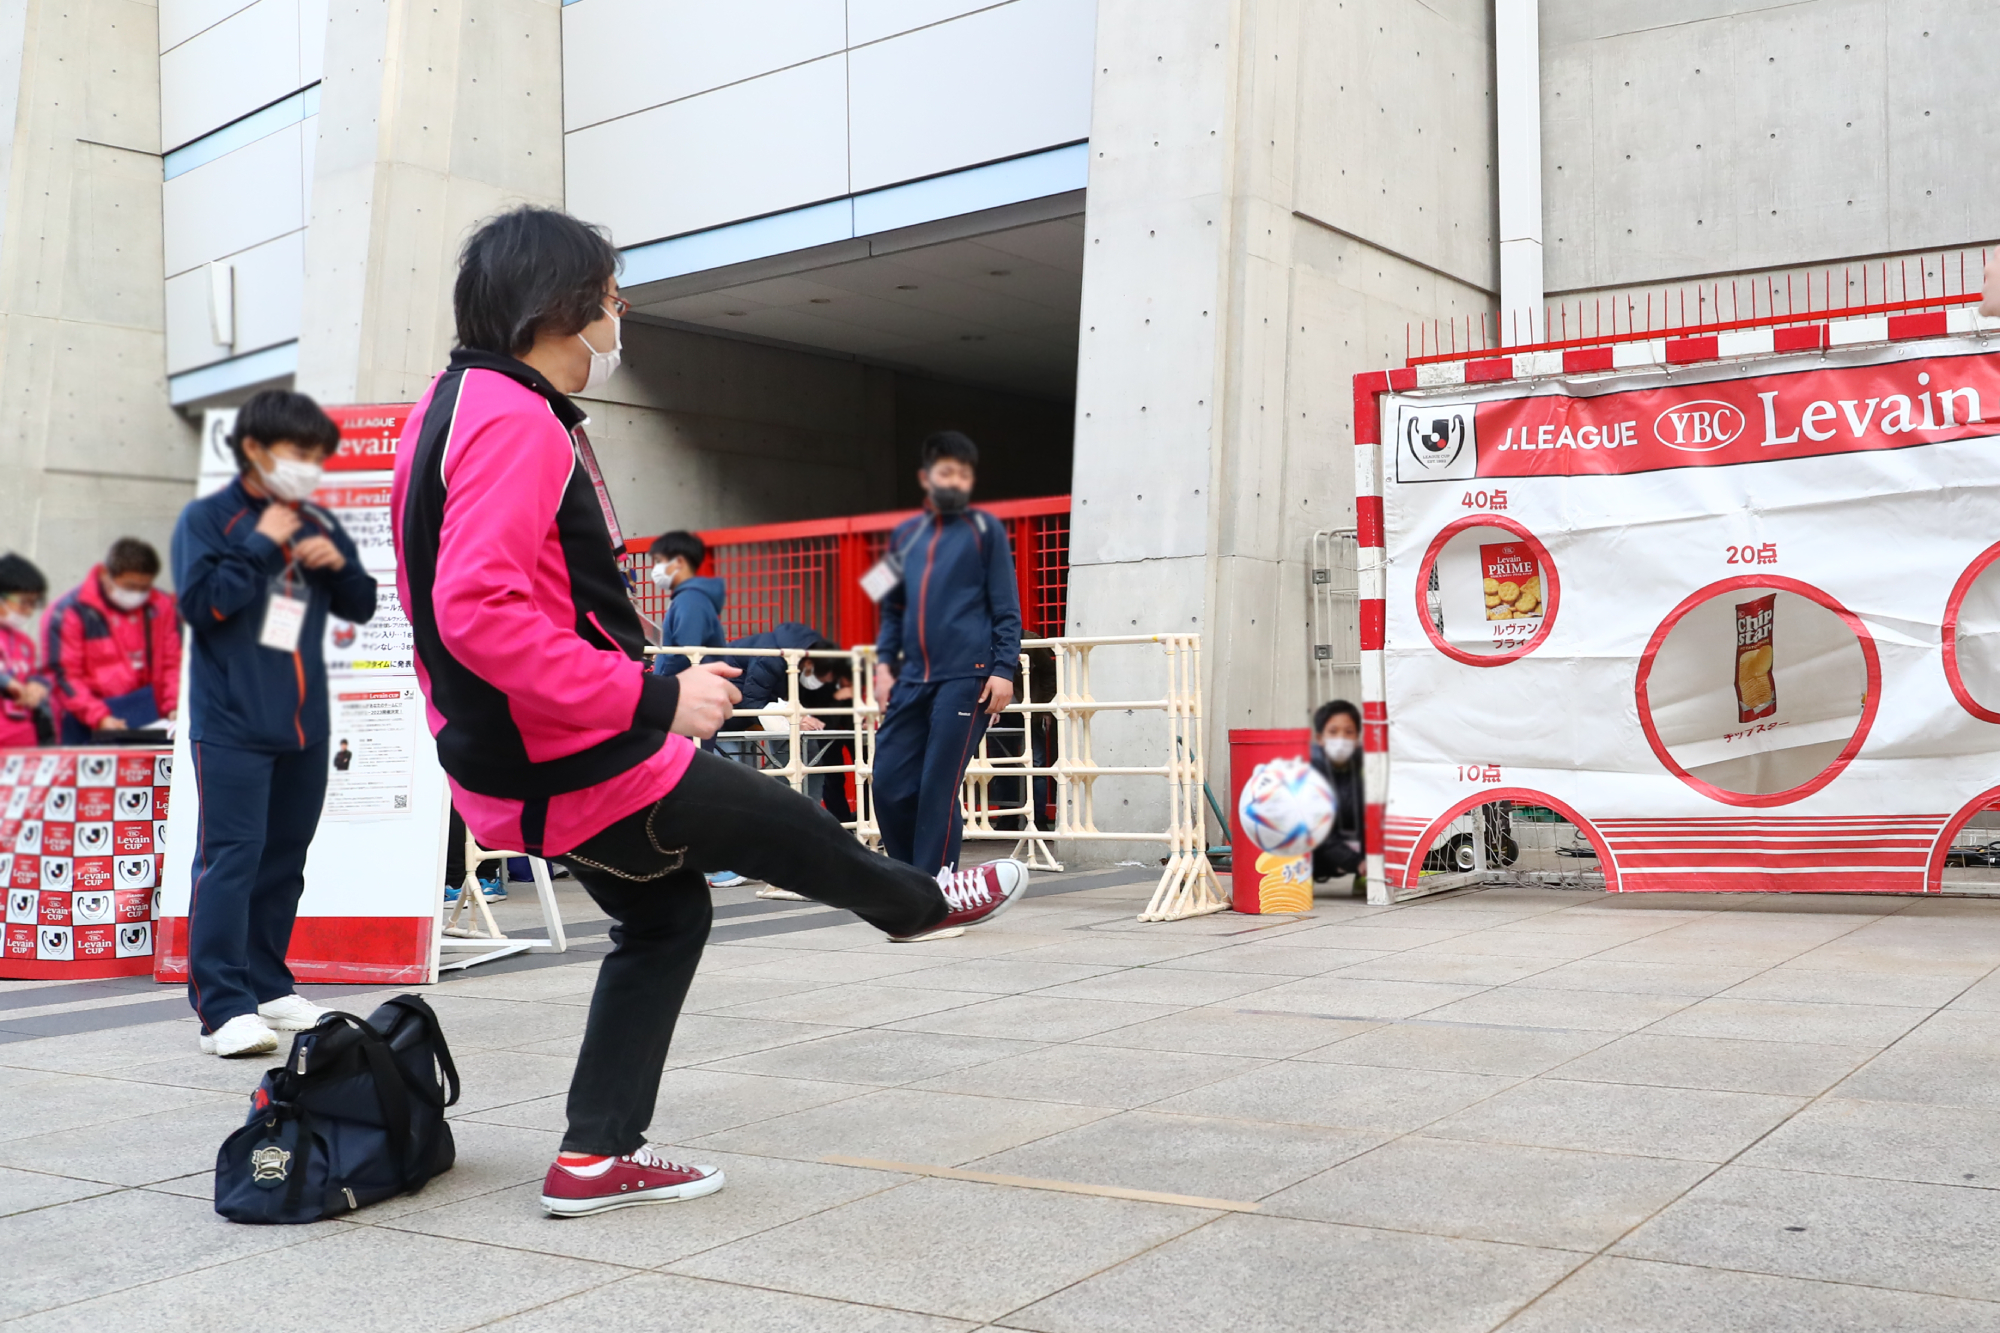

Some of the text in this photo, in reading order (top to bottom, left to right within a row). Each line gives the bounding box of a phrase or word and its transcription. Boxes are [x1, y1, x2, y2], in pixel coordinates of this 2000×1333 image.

[1497, 372, 1986, 451] J.LEAGUE YBC Levain
[343, 417, 396, 428] J.LEAGUE
[1462, 489, 1508, 510] 40点
[1726, 542, 1778, 565] 20点
[1497, 555, 1521, 564] Levain
[1488, 561, 1533, 576] PRIME
[1737, 607, 1773, 634] Chip
[1493, 623, 1538, 636] ルヴァン
[1738, 623, 1772, 647] star
[1723, 721, 1791, 743] チップスター
[1457, 763, 1502, 783] 10点
[117, 834, 150, 845] Levain
[77, 871, 111, 880] Levain
[40, 906, 69, 915] Levain
[119, 903, 149, 912] Levain
[47, 913, 64, 921] CUP
[127, 910, 143, 918] CUP
[7, 938, 35, 948] Levain
[77, 939, 112, 949] Levain
[12, 946, 28, 954] CUP
[85, 947, 104, 955] CUP
